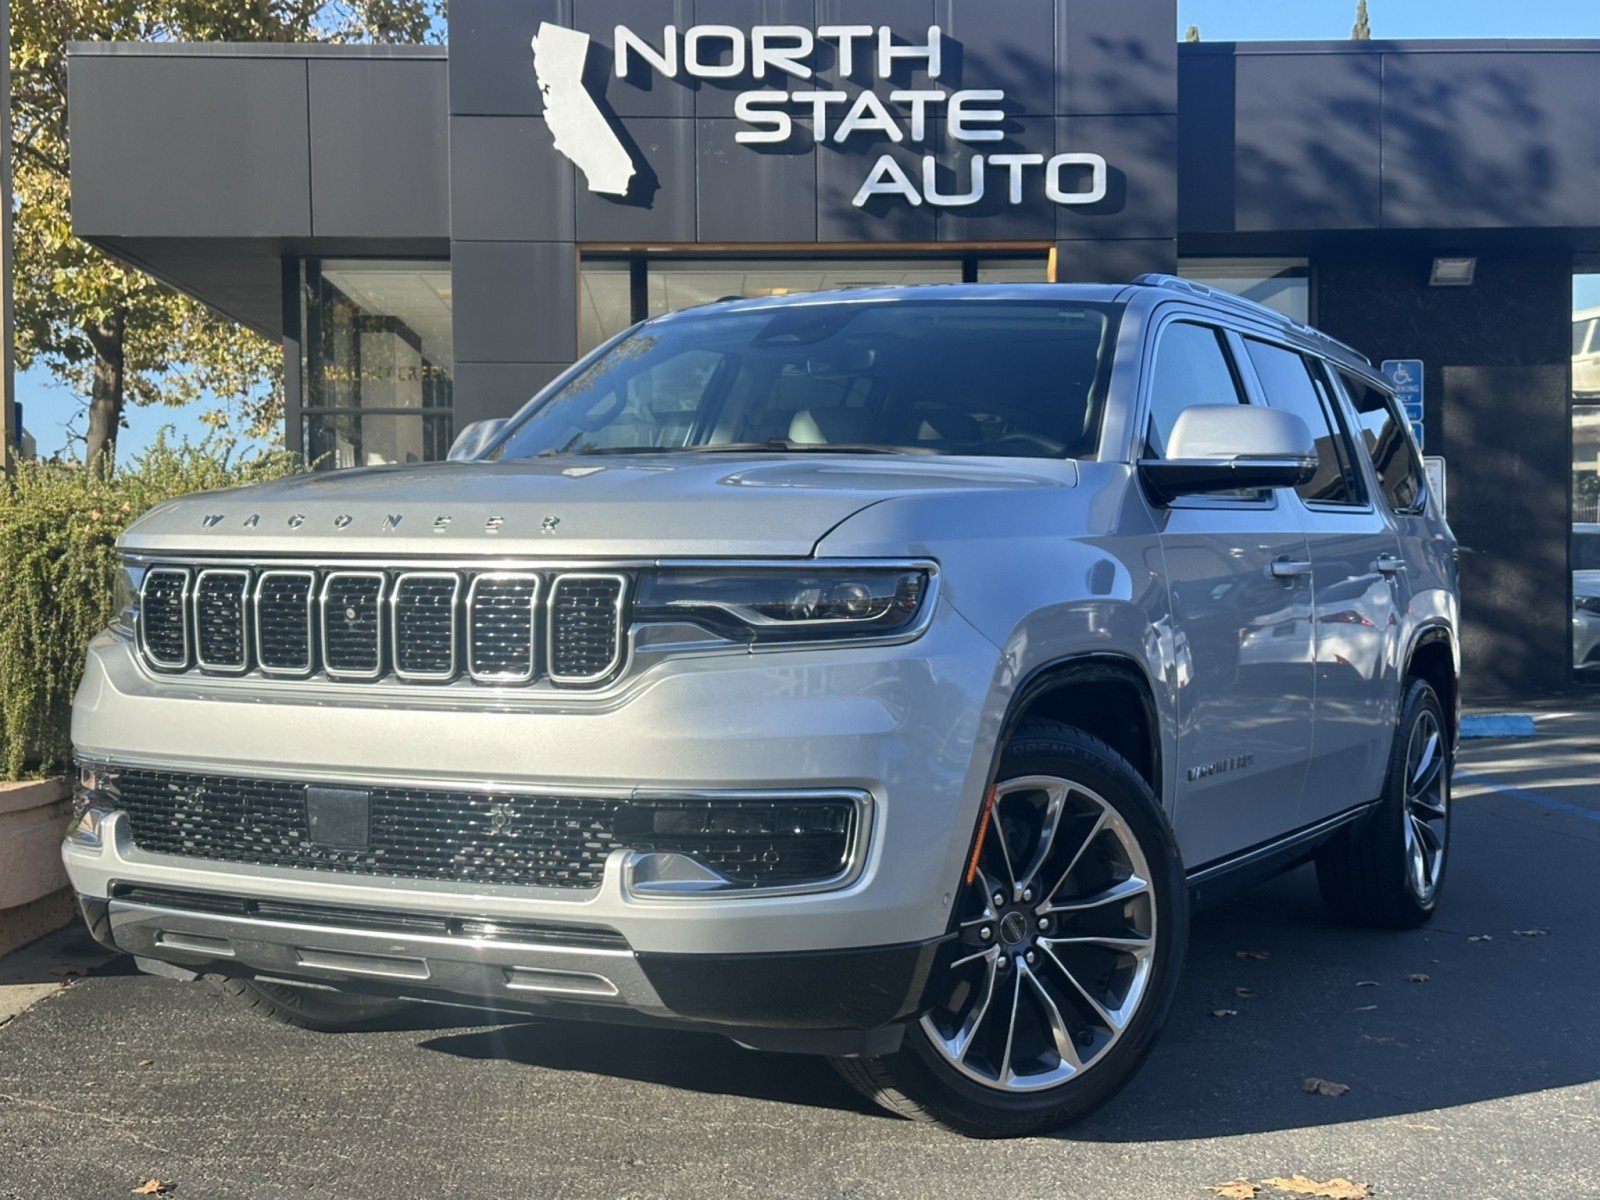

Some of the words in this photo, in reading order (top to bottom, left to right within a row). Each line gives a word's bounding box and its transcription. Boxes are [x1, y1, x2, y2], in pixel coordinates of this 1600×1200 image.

[614, 25, 941, 78] NORTH
[734, 90, 1004, 143] STATE
[852, 153, 1107, 206] AUTO
[201, 513, 561, 533] WAGONEER
